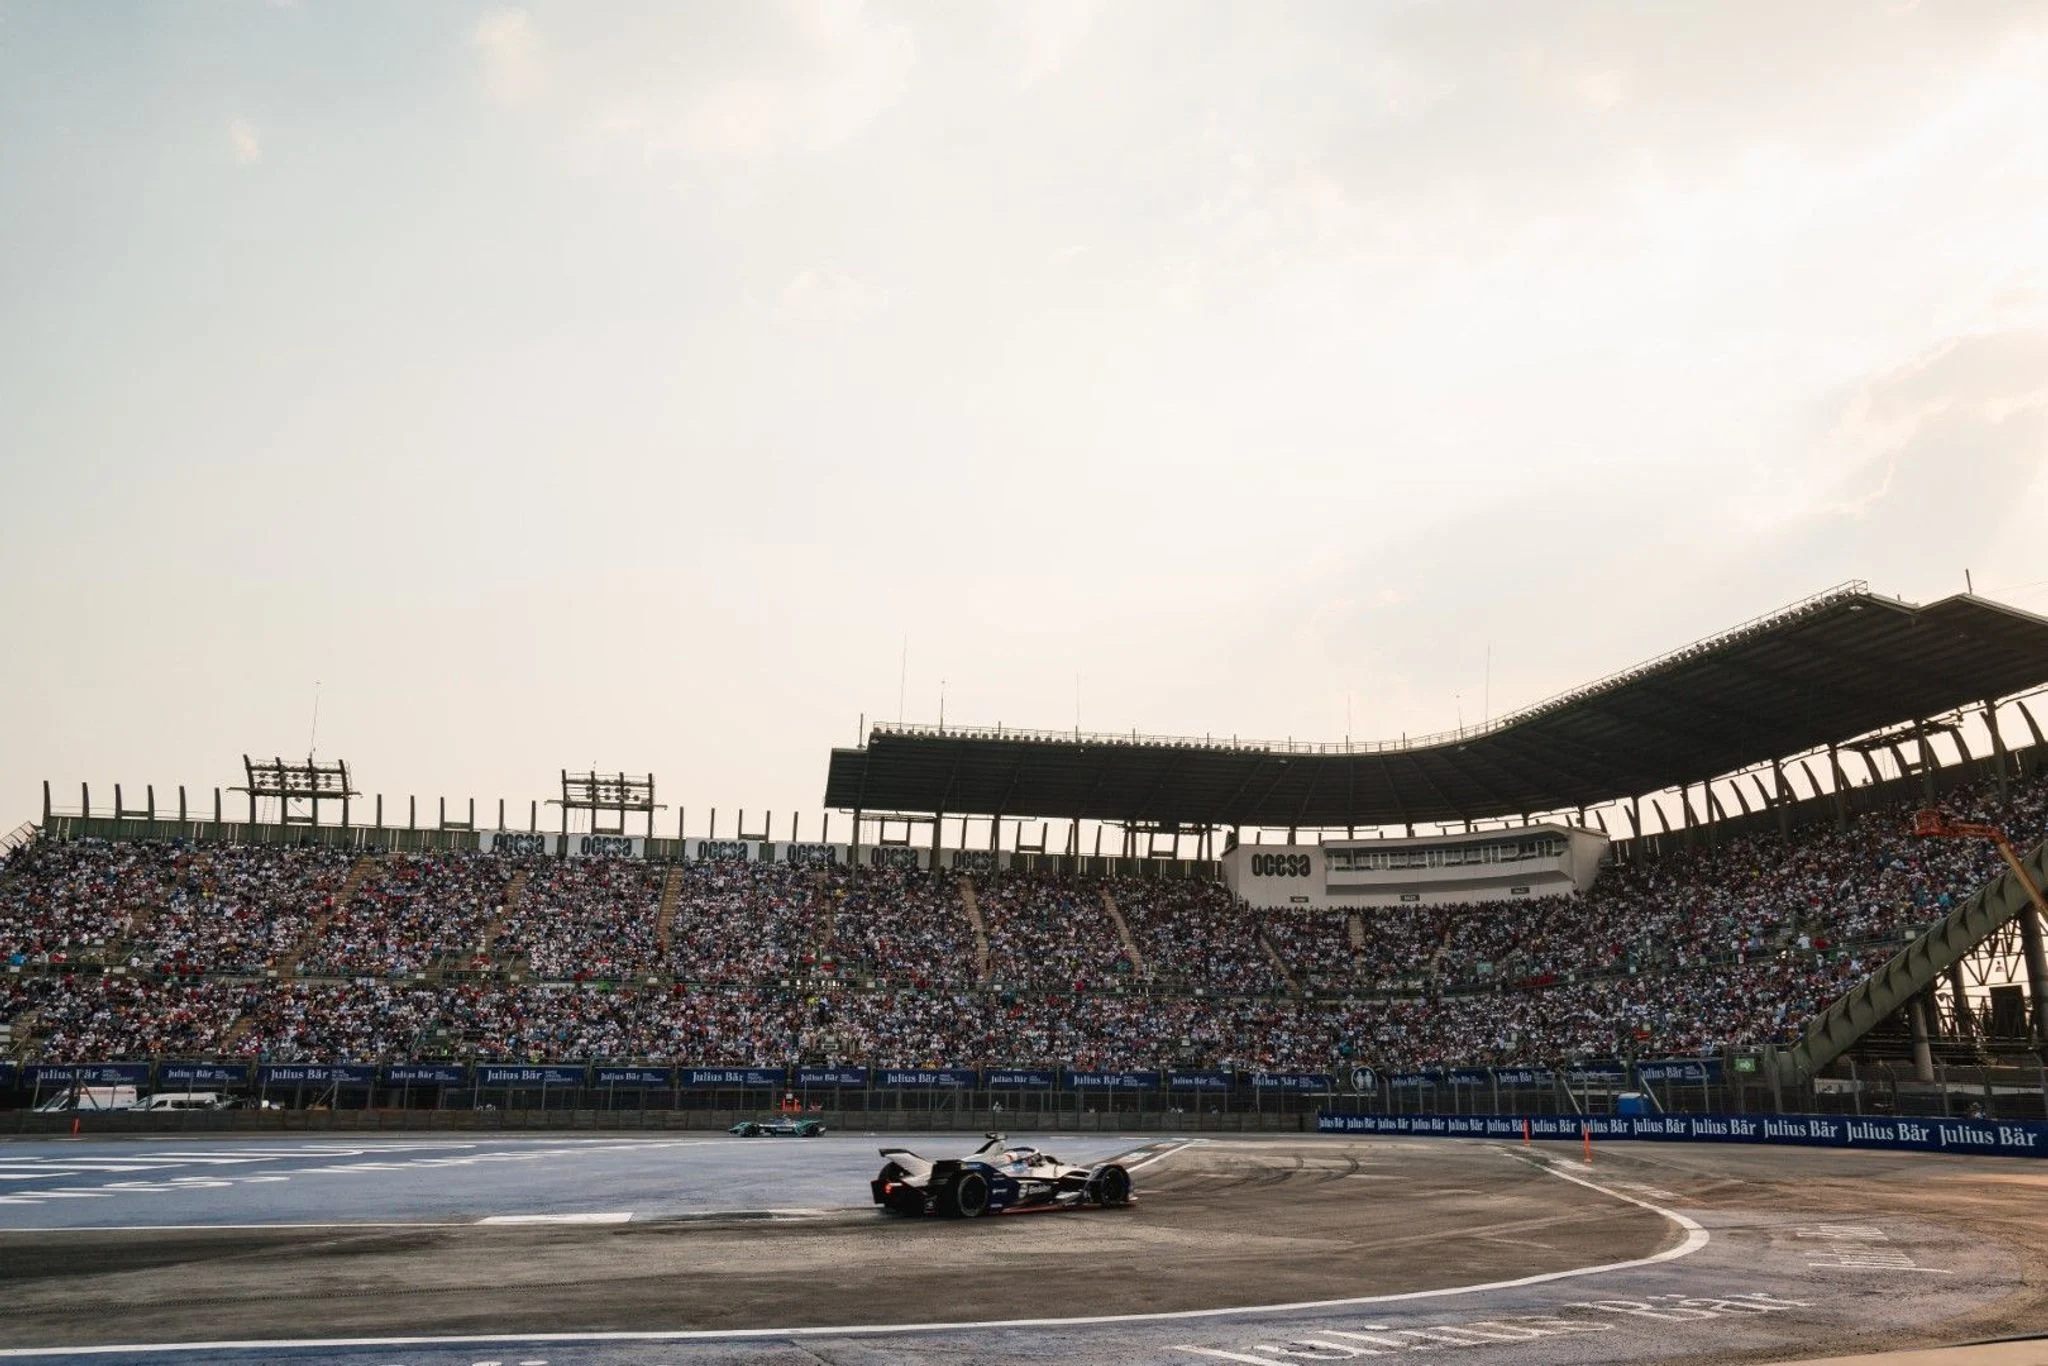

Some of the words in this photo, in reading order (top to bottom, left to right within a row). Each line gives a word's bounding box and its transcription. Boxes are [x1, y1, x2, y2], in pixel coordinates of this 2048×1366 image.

[196, 1069, 212, 1078] Bär
[271, 1069, 303, 1080] Julius
[308, 1069, 329, 1079] Bär
[418, 1070, 434, 1079] Bär
[487, 1070, 519, 1082] Julius
[522, 1070, 542, 1080] Bär
[626, 1072, 640, 1080] Bär
[693, 1071, 722, 1082] Julius
[725, 1071, 743, 1081] Bär
[824, 1073, 838, 1081] Bär
[888, 1073, 916, 1084] Julius
[919, 1073, 937, 1083] Bär
[1666, 1067, 1682, 1079] Bär
[1074, 1075, 1100, 1086] Julius
[1104, 1075, 1122, 1085] Bär
[1173, 1077, 1193, 1085] Julius
[1378, 1118, 1396, 1130] Julius
[1398, 1118, 1408, 1129] Bär
[1412, 1118, 1430, 1131] Julius
[1432, 1118, 1445, 1130] Bär
[1449, 1119, 1468, 1132] Julius
[1470, 1119, 1484, 1131] Bär
[1487, 1119, 1510, 1134] Julius
[1512, 1119, 1527, 1132] Bä
[1531, 1119, 1557, 1135] Julius
[1559, 1119, 1576, 1133] Bär
[1581, 1119, 1608, 1134] Julius
[1610, 1119, 1628, 1133] Bär
[1634, 1119, 1663, 1135] Julius
[1666, 1119, 1687, 1134] Bär
[1692, 1119, 1727, 1137] Julius
[1731, 1120, 1756, 1135] Bär
[1764, 1119, 1806, 1138] Julius
[1810, 1120, 1838, 1138] Bär
[1846, 1121, 1894, 1141] Julius
[1898, 1123, 1931, 1142] Bär
[1940, 1124, 1994, 1146] Julius
[1999, 1126, 2037, 1147] Bär
